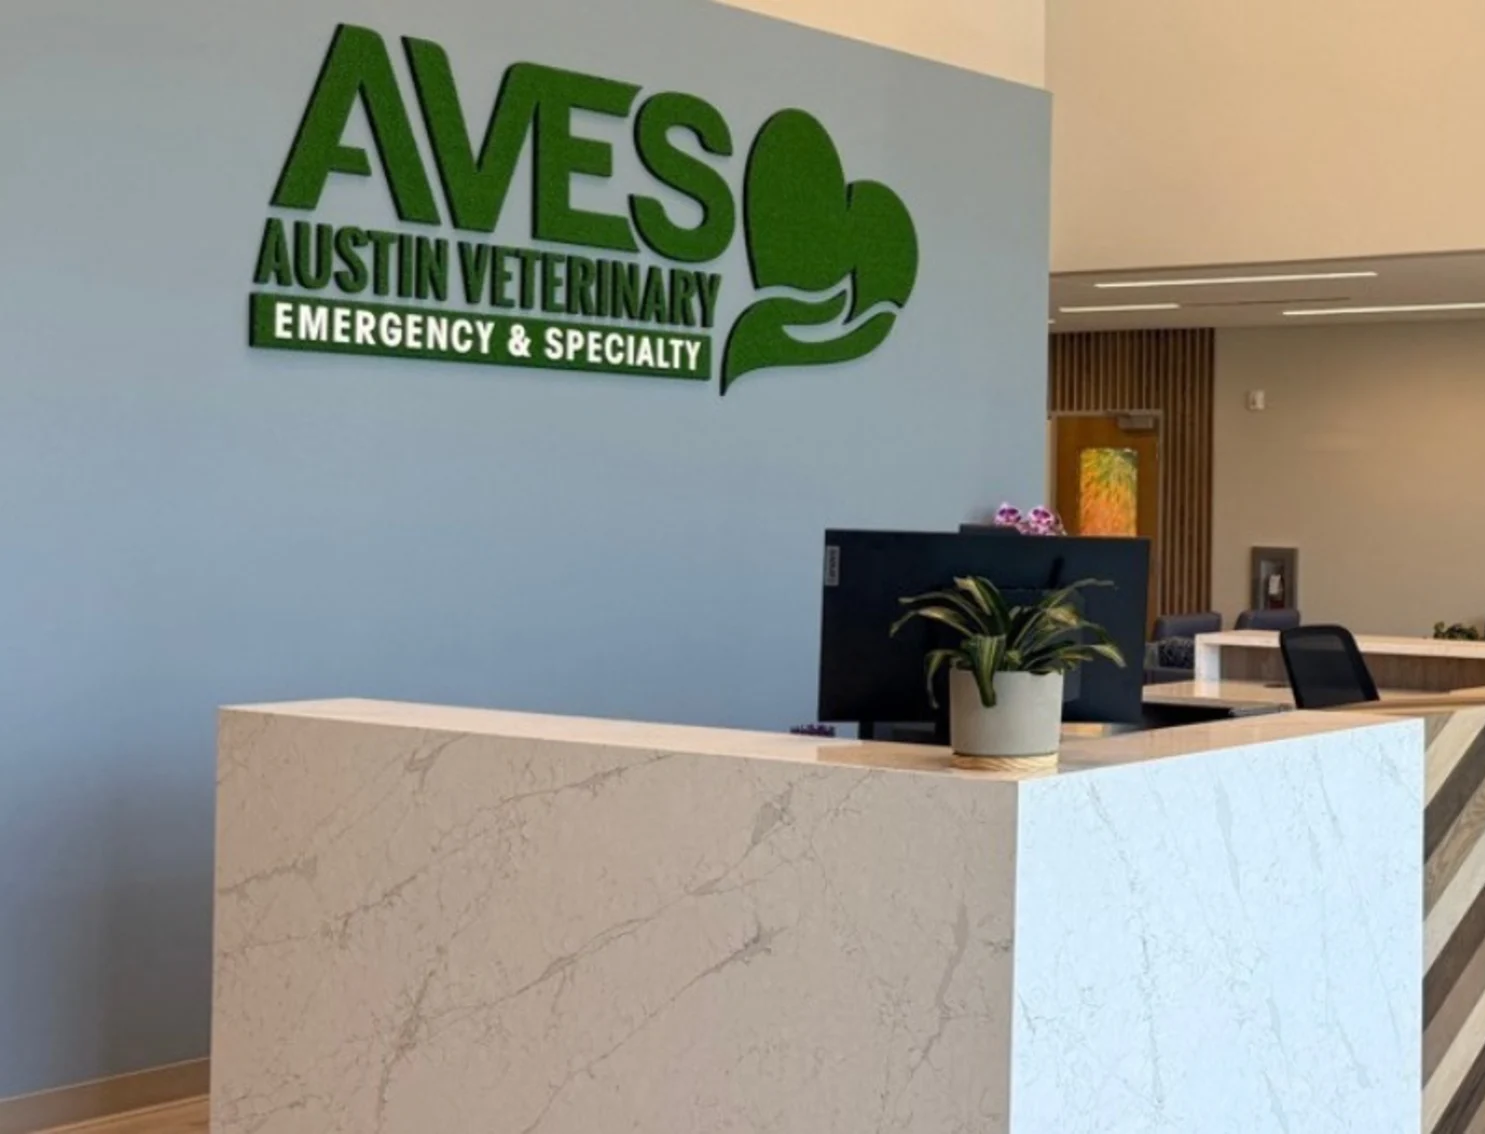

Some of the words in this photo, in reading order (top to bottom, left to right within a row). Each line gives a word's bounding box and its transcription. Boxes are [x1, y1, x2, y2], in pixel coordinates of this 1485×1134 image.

[268, 23, 736, 263] AVES
[254, 217, 450, 303] AUSTIN
[457, 241, 722, 329] VETERINARY
[273, 301, 496, 355] EMERGENCY
[507, 324, 533, 358] &
[543, 326, 702, 372] SPECIALTY
